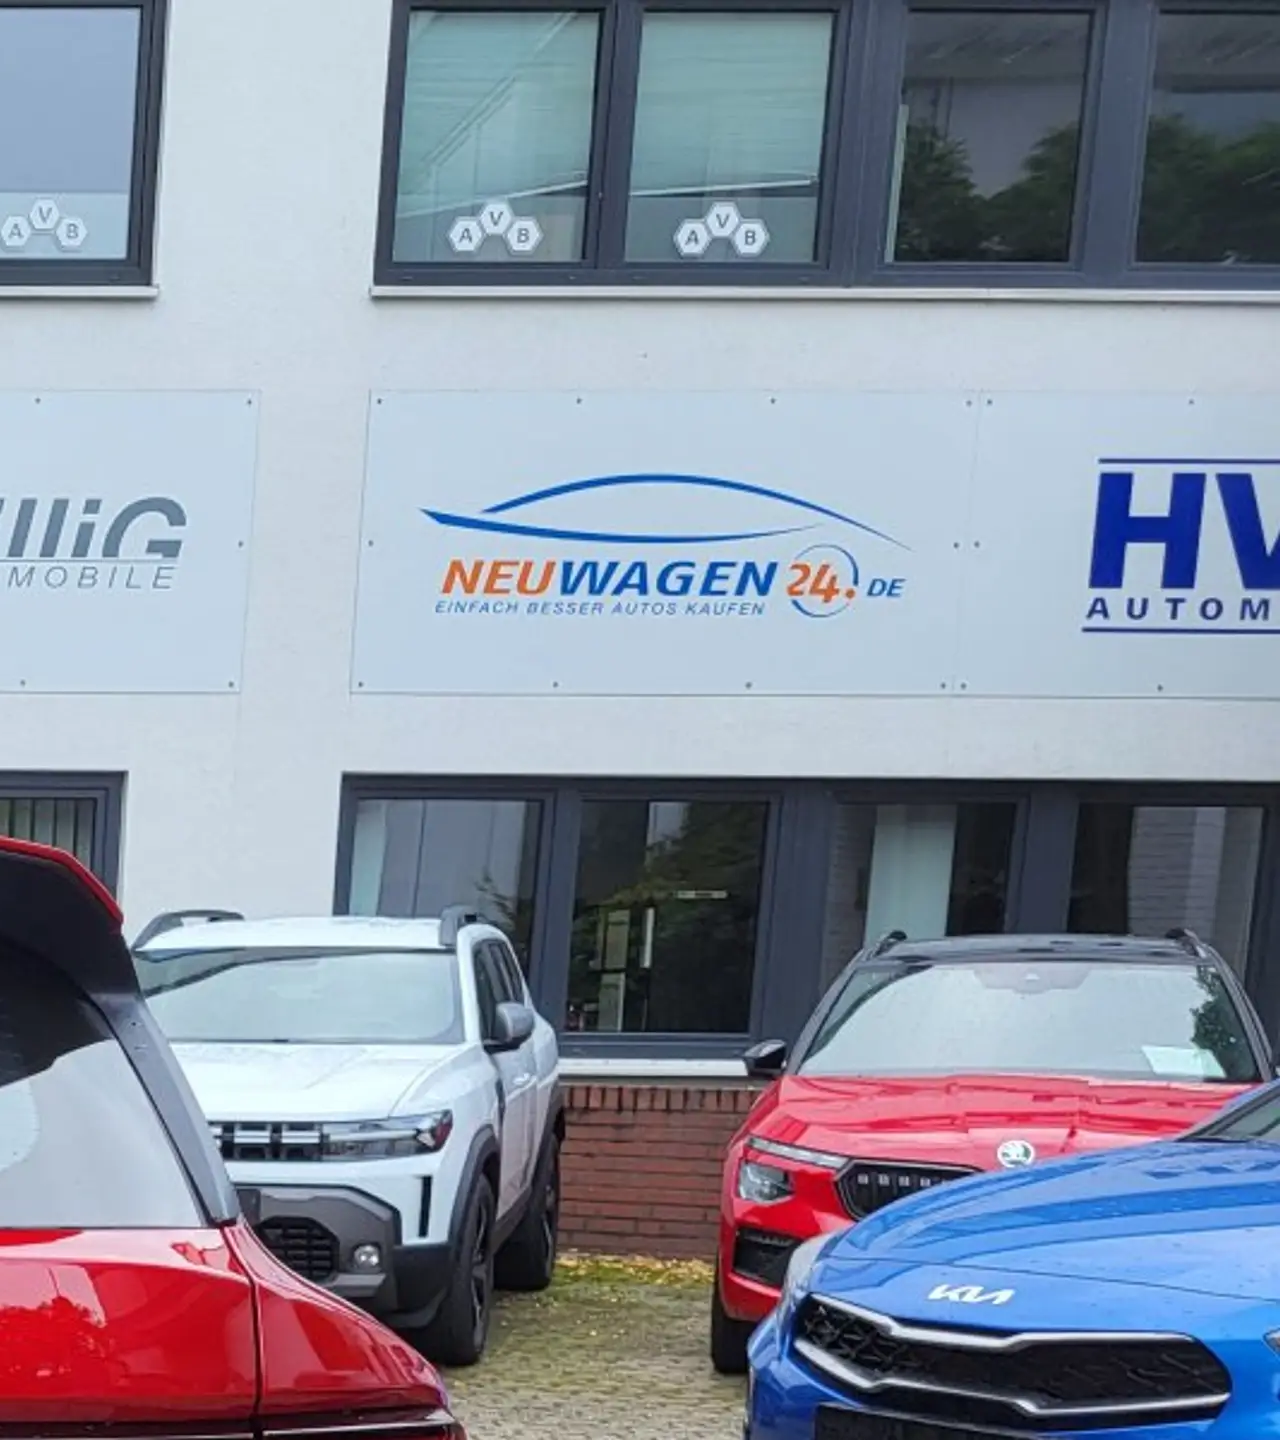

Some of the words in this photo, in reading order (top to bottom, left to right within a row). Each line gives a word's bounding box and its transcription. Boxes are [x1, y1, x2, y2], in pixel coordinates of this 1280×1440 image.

[434, 600, 519, 615] EINFACH
[526, 602, 604, 616] BESSER
[610, 602, 678, 616] AUTOS
[684, 602, 765, 616] KAUFEN
[1086, 597, 1271, 621] AUTOM
[927, 1284, 1016, 1305] KIA
